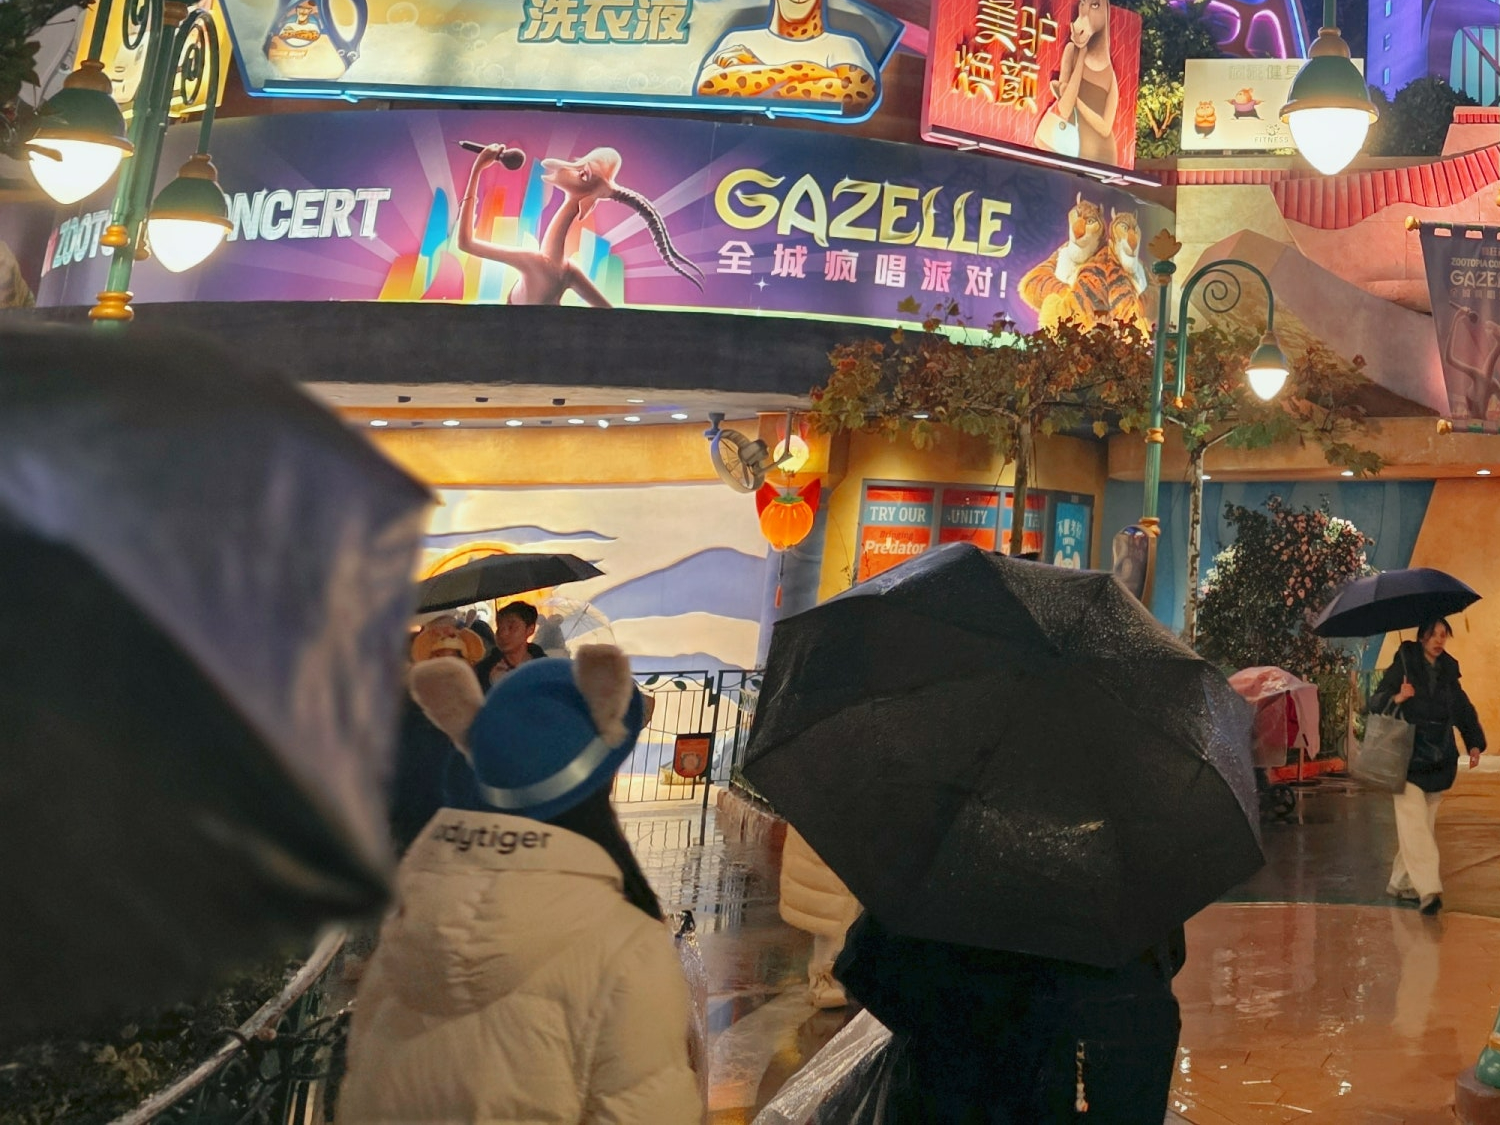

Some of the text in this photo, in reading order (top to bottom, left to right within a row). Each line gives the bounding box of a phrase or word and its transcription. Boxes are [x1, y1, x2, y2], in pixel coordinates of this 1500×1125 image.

[226, 188, 392, 242] NCERT
[714, 168, 1013, 258] GAZELLE
[1451, 257, 1488, 268] ZOOTOPIA
[870, 506, 926, 522] TRY OUR
[864, 539, 927, 555] Predator
